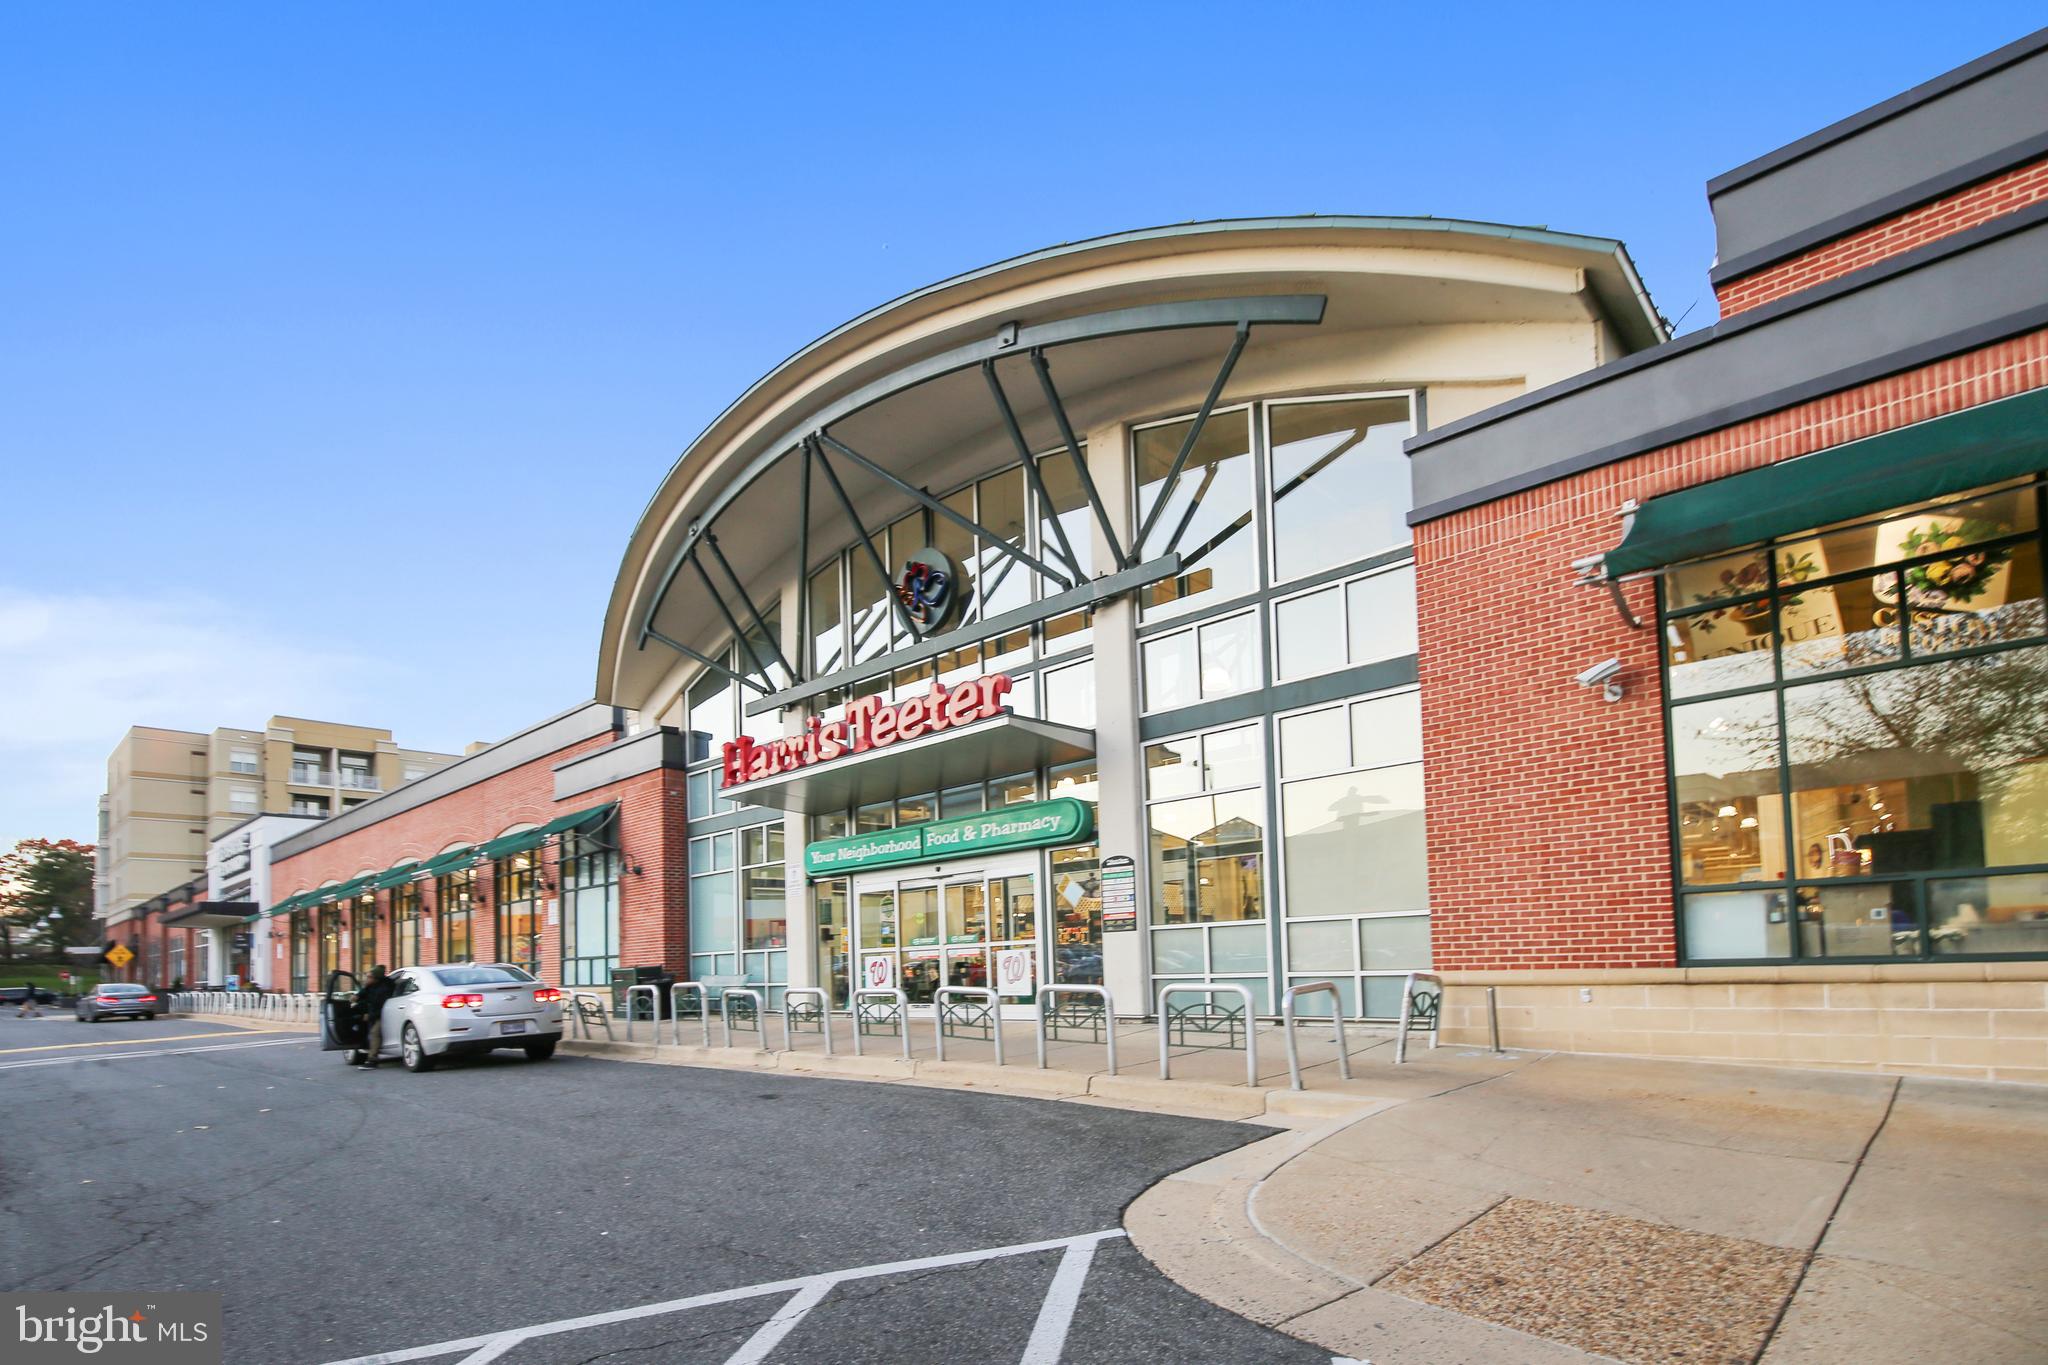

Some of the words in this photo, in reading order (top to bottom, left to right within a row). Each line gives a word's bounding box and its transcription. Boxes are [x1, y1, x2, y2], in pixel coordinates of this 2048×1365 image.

[721, 715, 849, 788] Harris
[846, 673, 1013, 753] Teeter
[811, 850, 836, 864] Your
[838, 835, 922, 862] Neighborhood
[926, 828, 960, 847] Food
[962, 825, 977, 841] &
[980, 815, 1062, 839] Pharmacy
